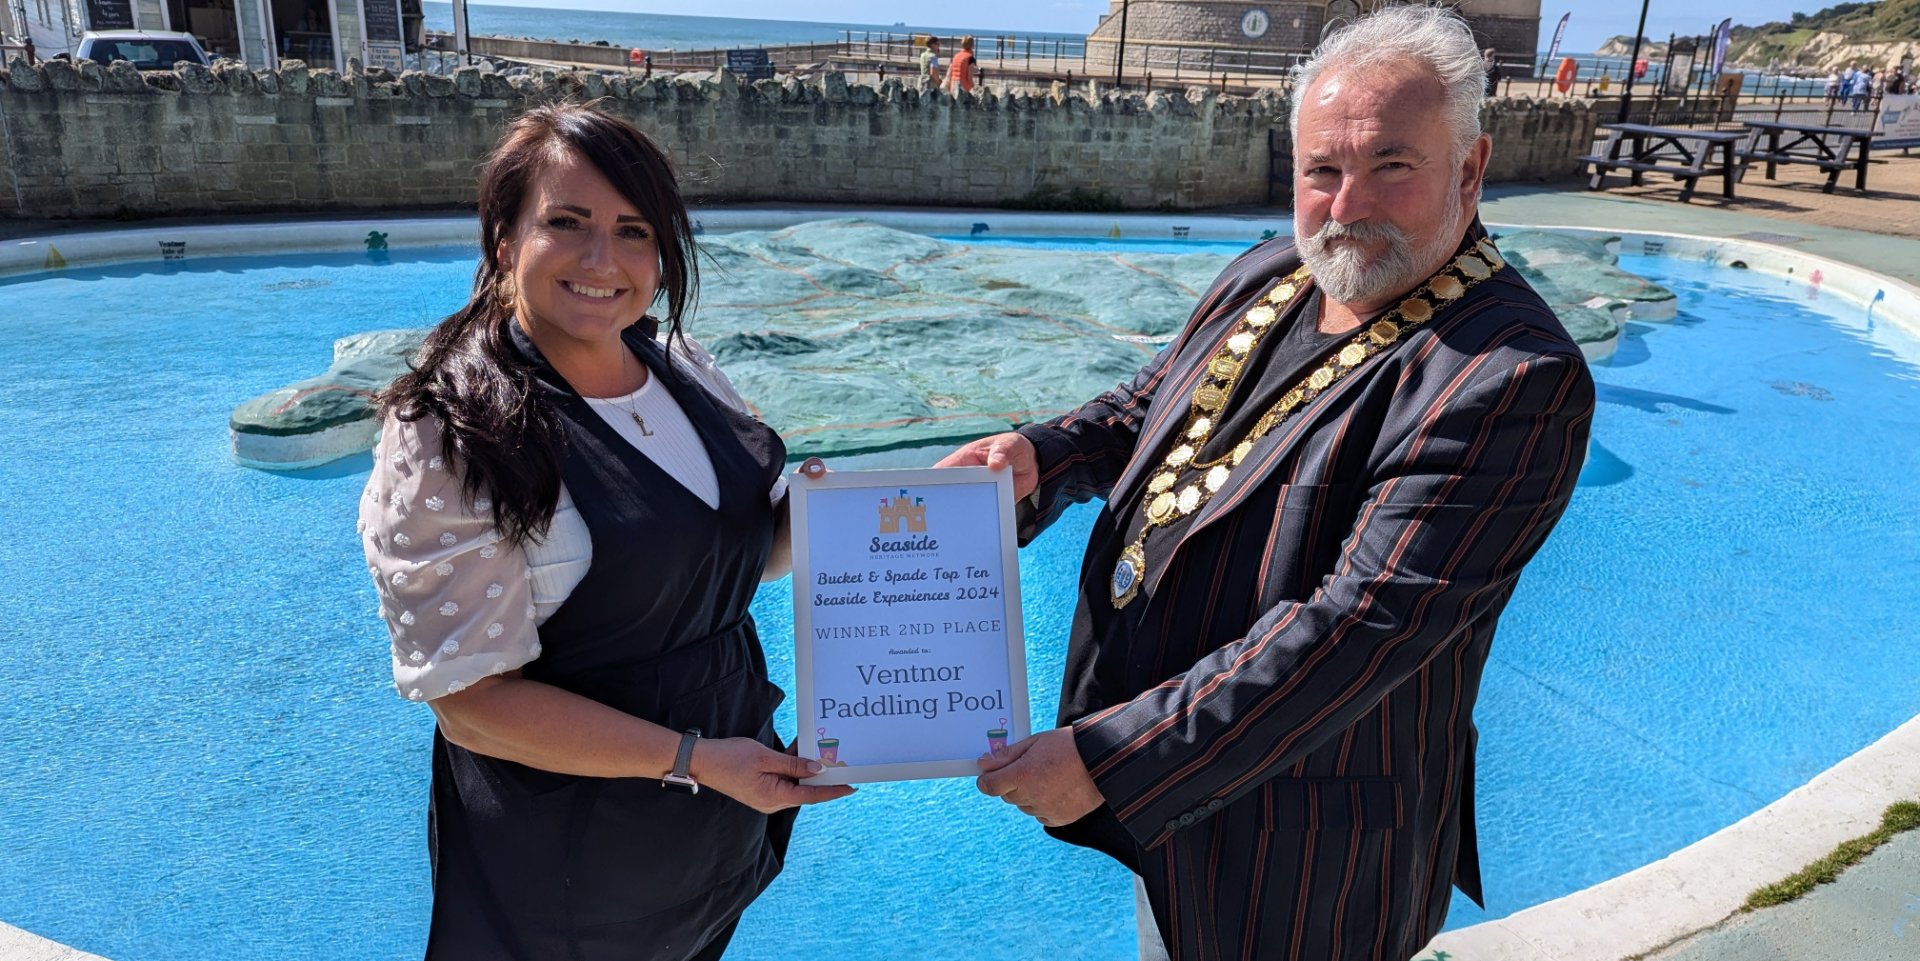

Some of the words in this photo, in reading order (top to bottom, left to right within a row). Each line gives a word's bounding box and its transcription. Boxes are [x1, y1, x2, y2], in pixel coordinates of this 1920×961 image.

[869, 534, 939, 552] Seaside
[817, 571, 864, 585] Bucket
[868, 570, 879, 582] &
[884, 569, 928, 585] Spade
[933, 567, 960, 583] Top
[965, 566, 989, 579] Ten
[814, 591, 867, 606] Seaside
[873, 590, 950, 607] Experiences
[956, 586, 999, 601] 2024
[815, 624, 890, 640] WINNER
[899, 623, 934, 636] 2ND
[943, 620, 1001, 634] PLACE
[856, 664, 965, 686] Ventnor
[819, 694, 938, 720] Paddling
[946, 689, 1005, 712] Pool
